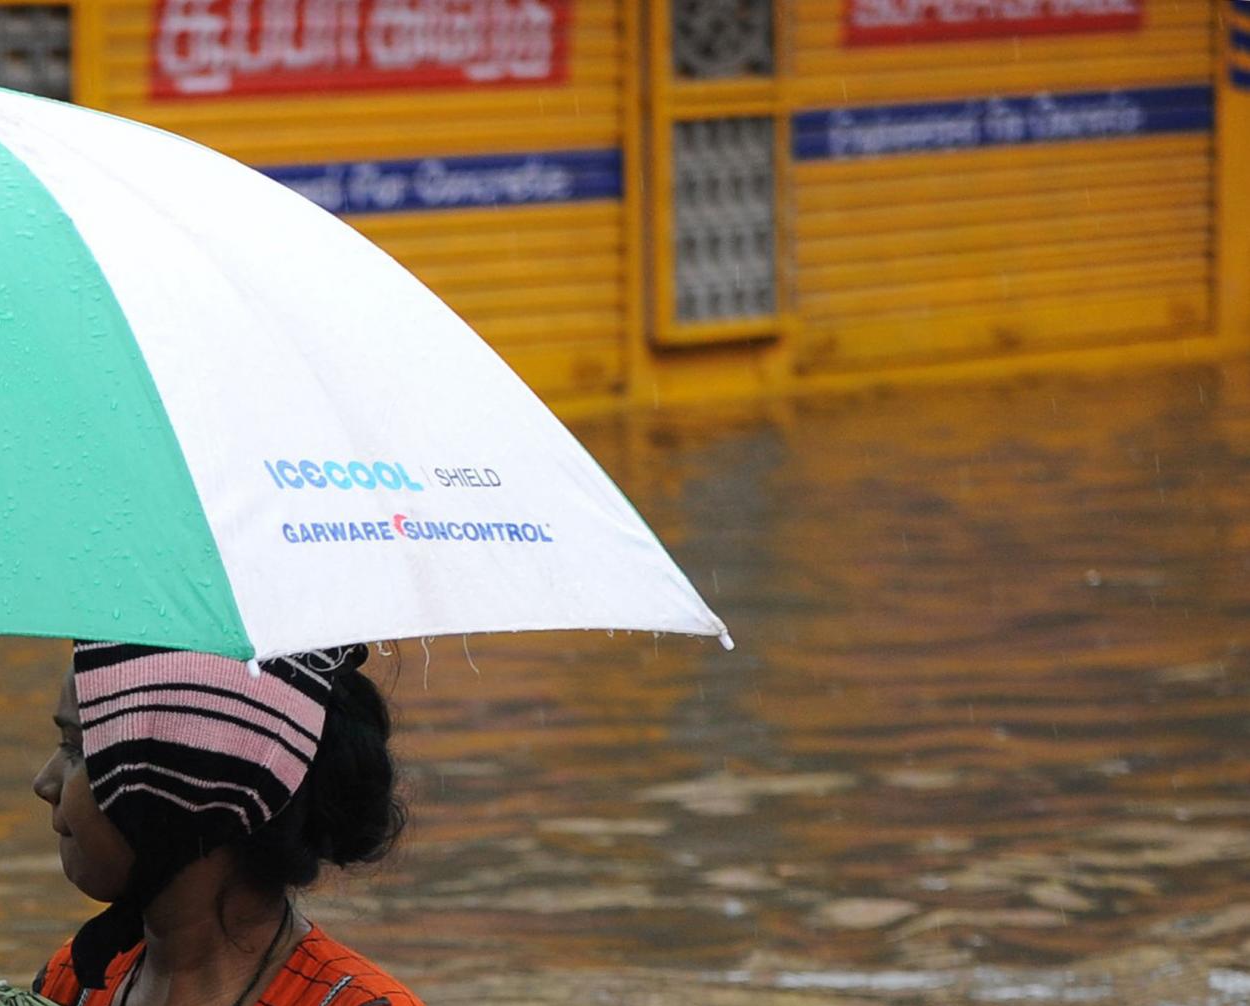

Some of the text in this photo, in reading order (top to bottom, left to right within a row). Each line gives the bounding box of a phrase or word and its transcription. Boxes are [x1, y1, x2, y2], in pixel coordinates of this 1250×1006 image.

[263, 459, 502, 492] ICECOOL SHIELD
[282, 522, 553, 543] GARWARE SUNCONTROL
